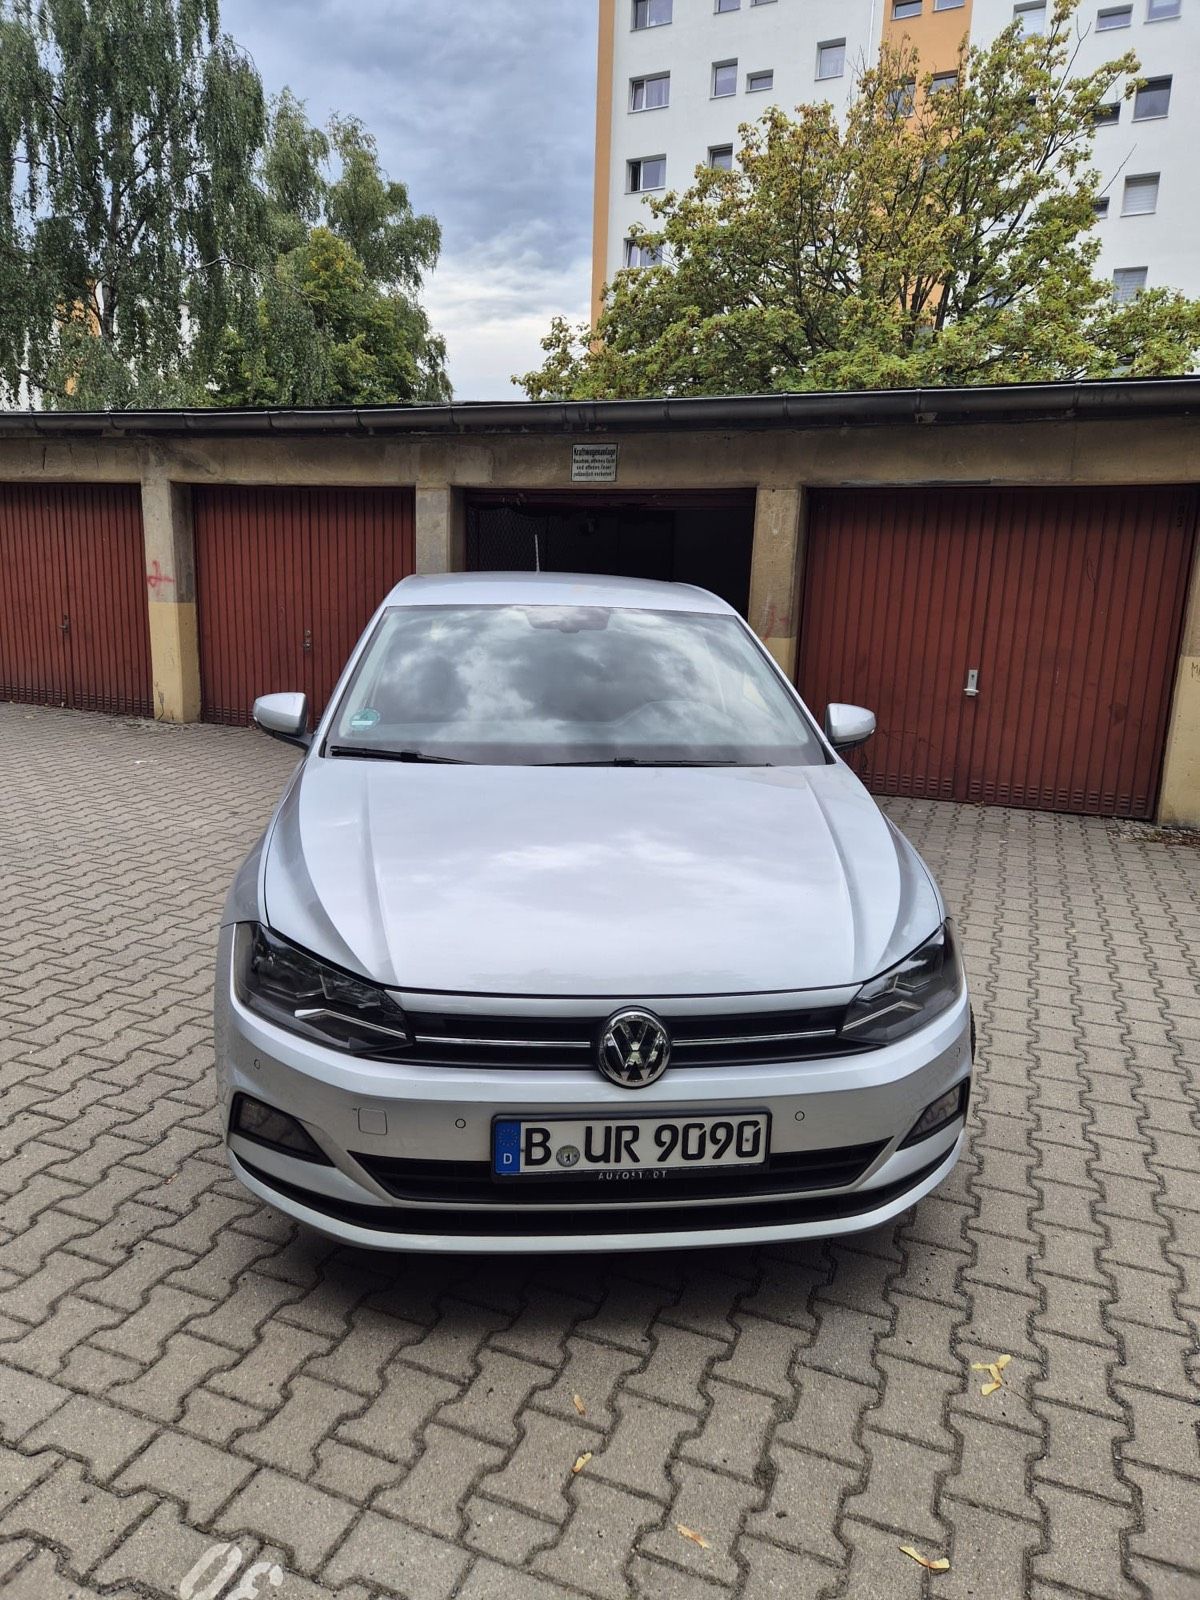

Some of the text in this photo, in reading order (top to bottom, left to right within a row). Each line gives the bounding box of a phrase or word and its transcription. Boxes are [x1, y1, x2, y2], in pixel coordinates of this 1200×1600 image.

[503, 1120, 762, 1166] D B UR 9090
